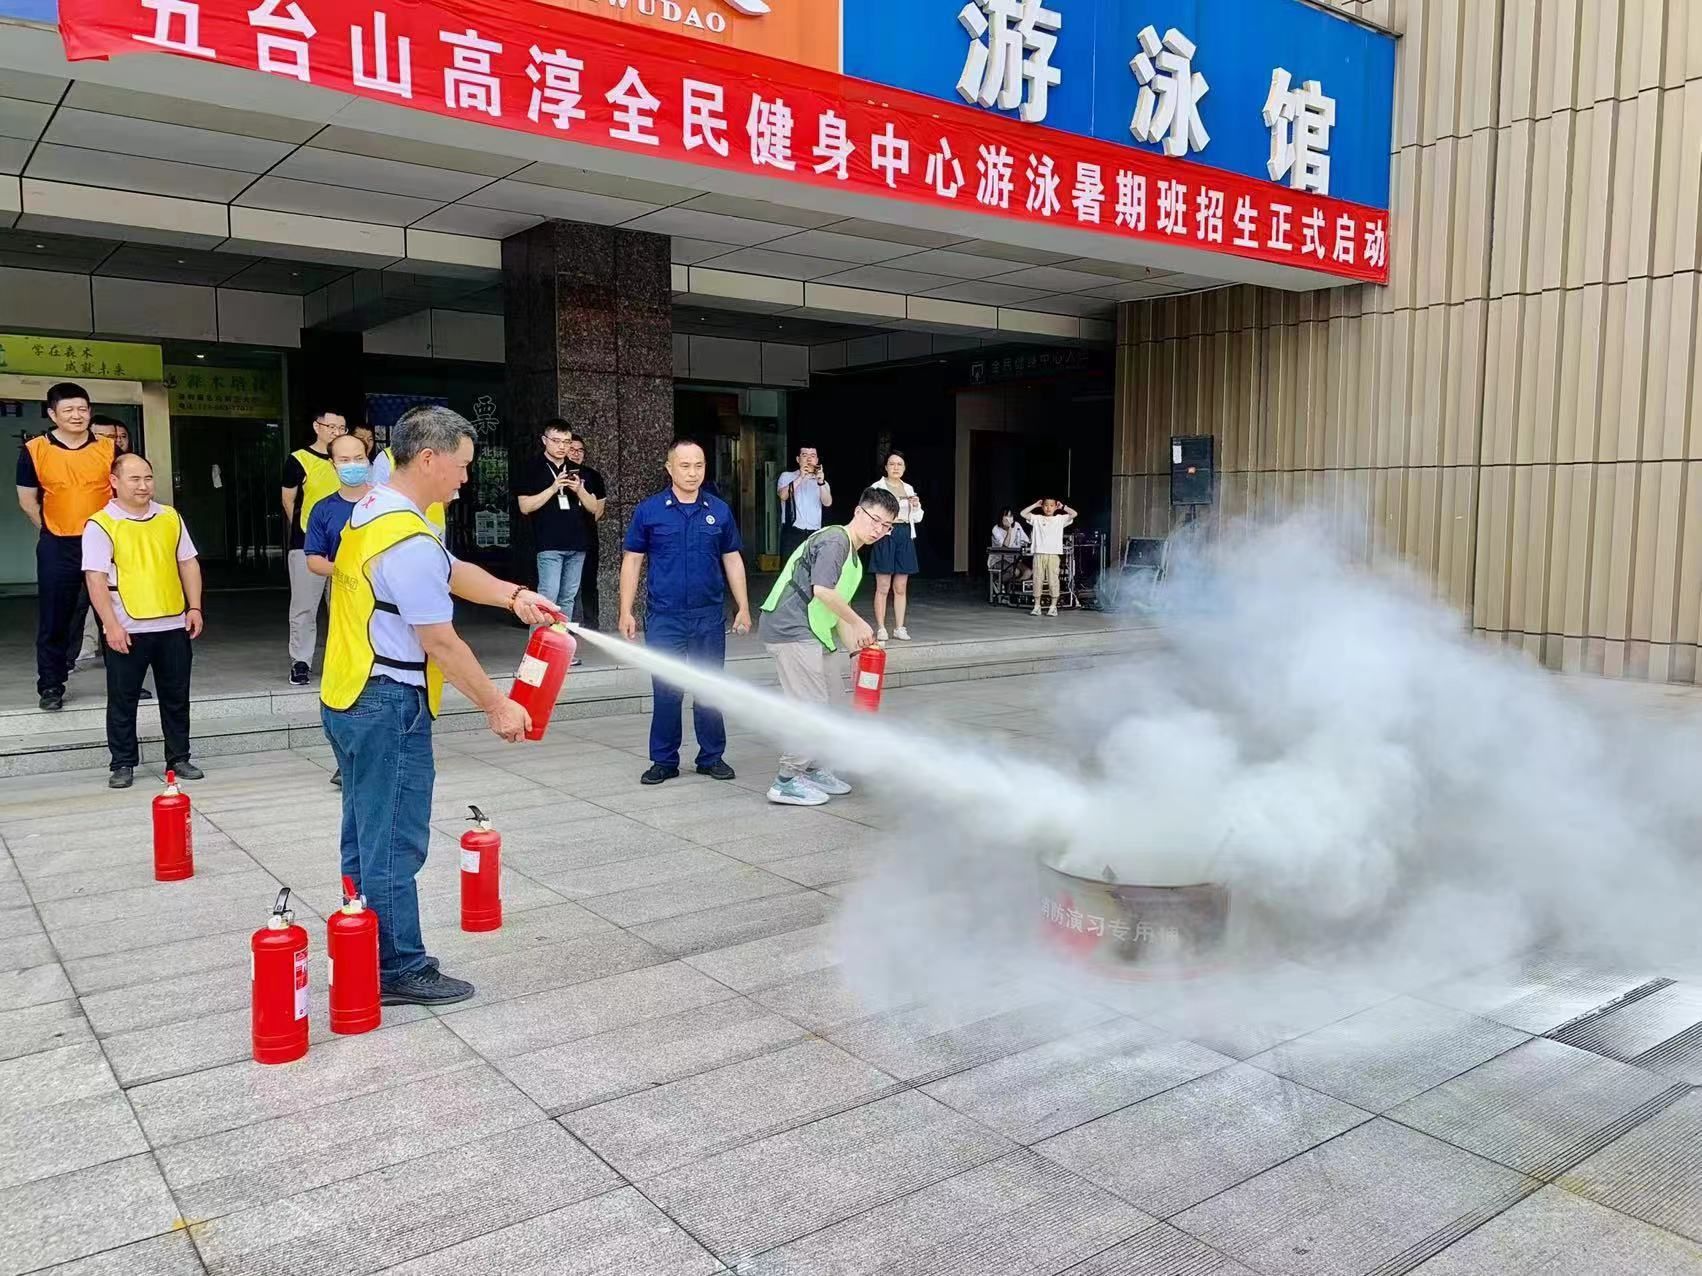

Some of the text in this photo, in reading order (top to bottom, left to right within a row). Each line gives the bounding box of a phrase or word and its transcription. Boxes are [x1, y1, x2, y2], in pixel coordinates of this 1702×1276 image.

[131, 0, 1385, 268] 五台山高淳全民健身中心游泳暑期班招生正式启动
[956, 0, 1332, 195] 游泳馆
[65, 360, 126, 376] 成就未来
